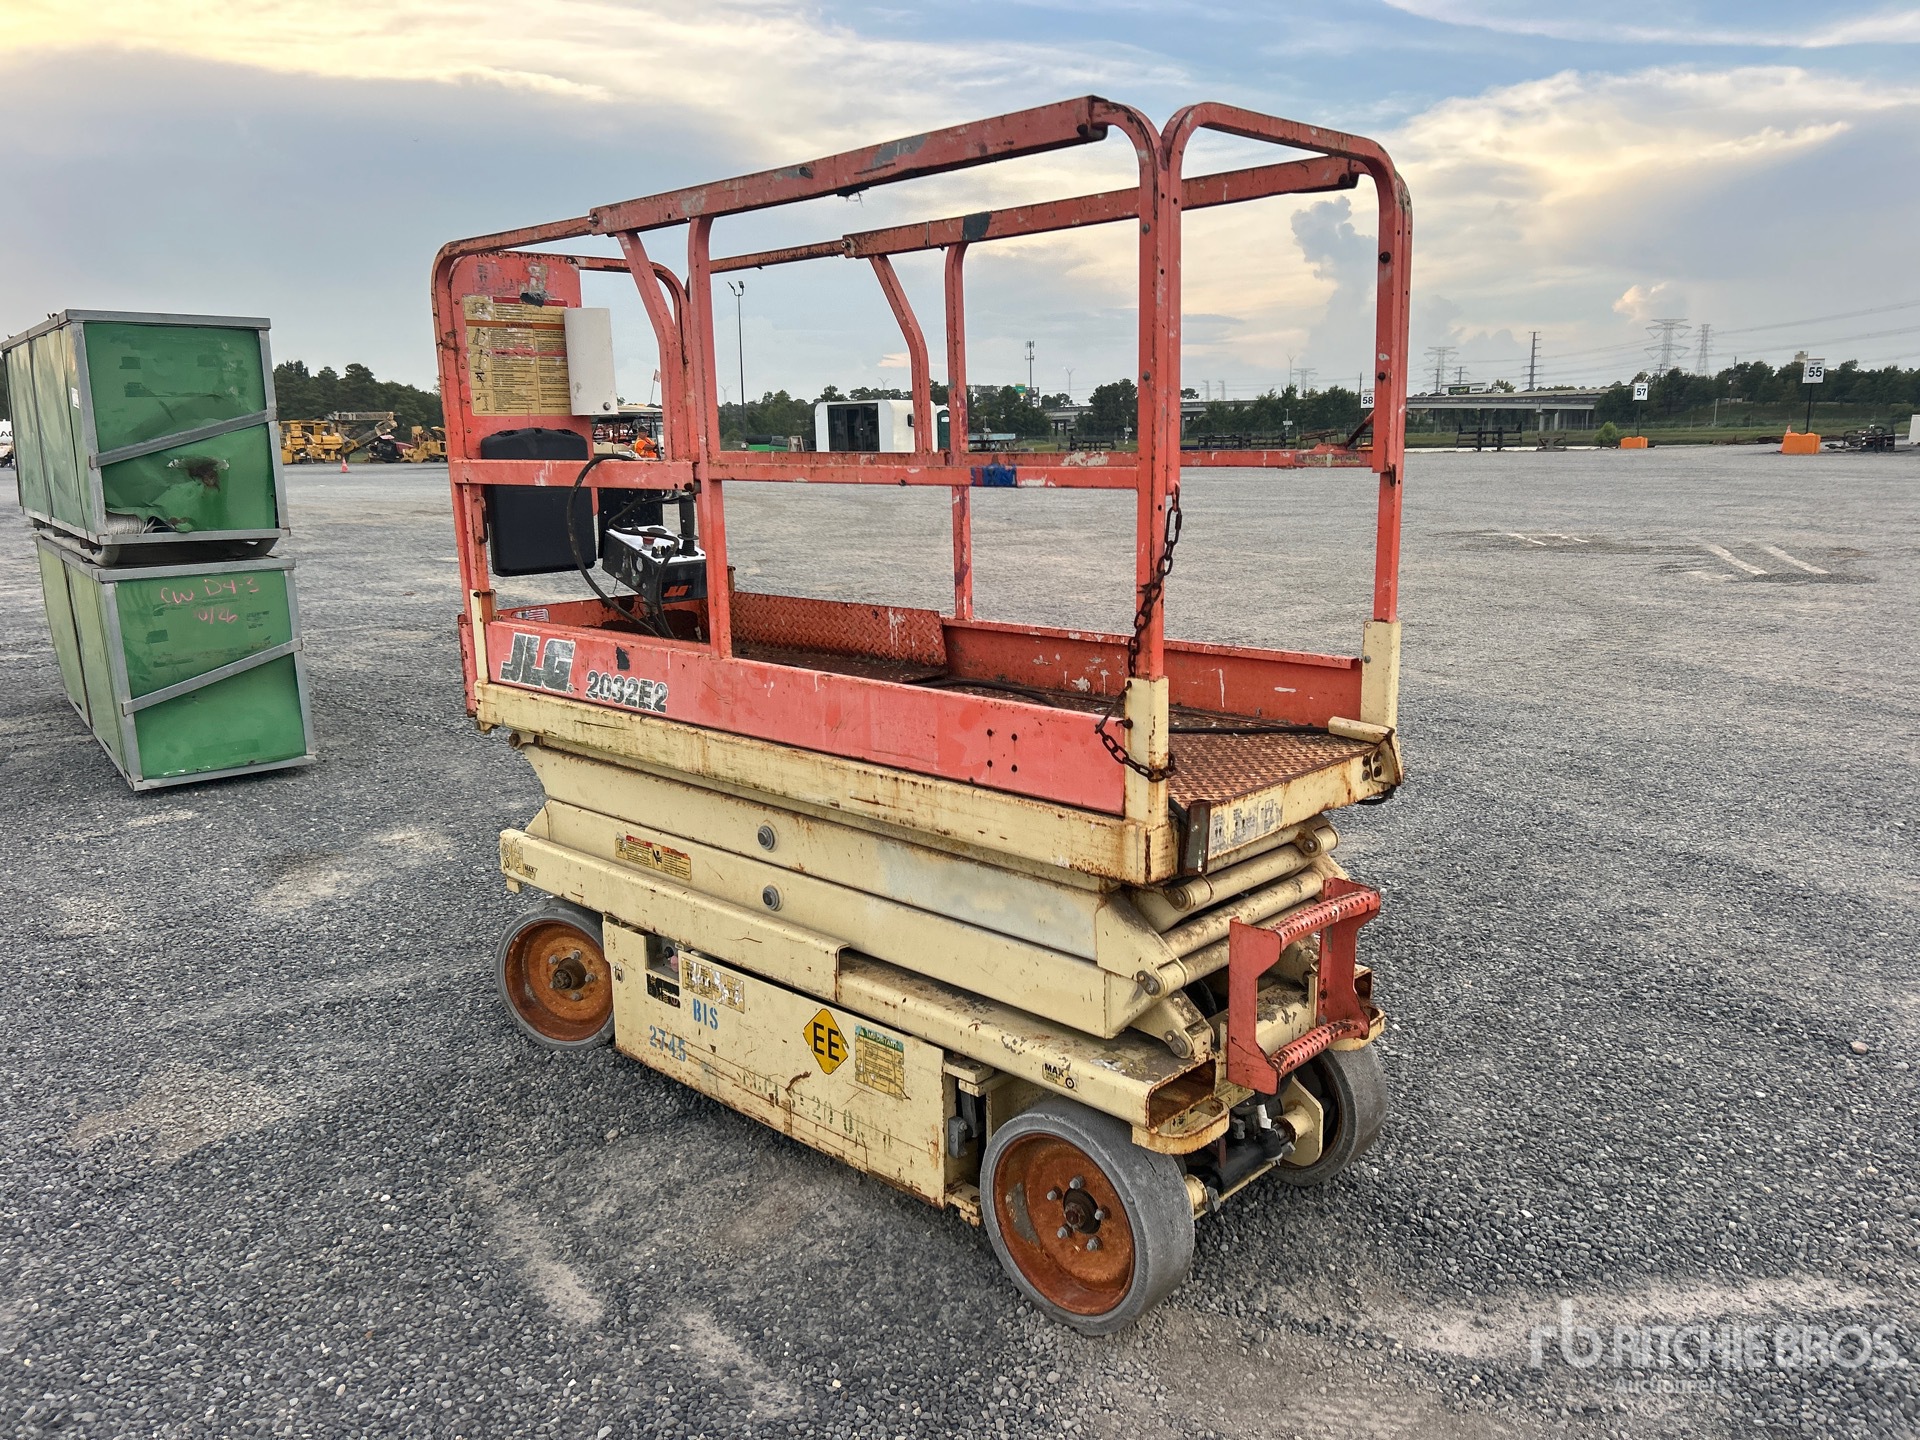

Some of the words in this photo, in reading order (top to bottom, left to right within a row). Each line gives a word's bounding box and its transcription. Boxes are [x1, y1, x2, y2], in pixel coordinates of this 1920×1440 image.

[1808, 366, 1822, 378] 55
[1362, 396, 1374, 405] 58
[1636, 387, 1647, 397] 57
[499, 632, 577, 693] JLG
[585, 670, 669, 715] 2032E2
[692, 998, 719, 1031] BIS
[649, 1024, 687, 1063] 2745
[812, 1021, 840, 1062] EE
[1044, 1062, 1065, 1078] MAX
